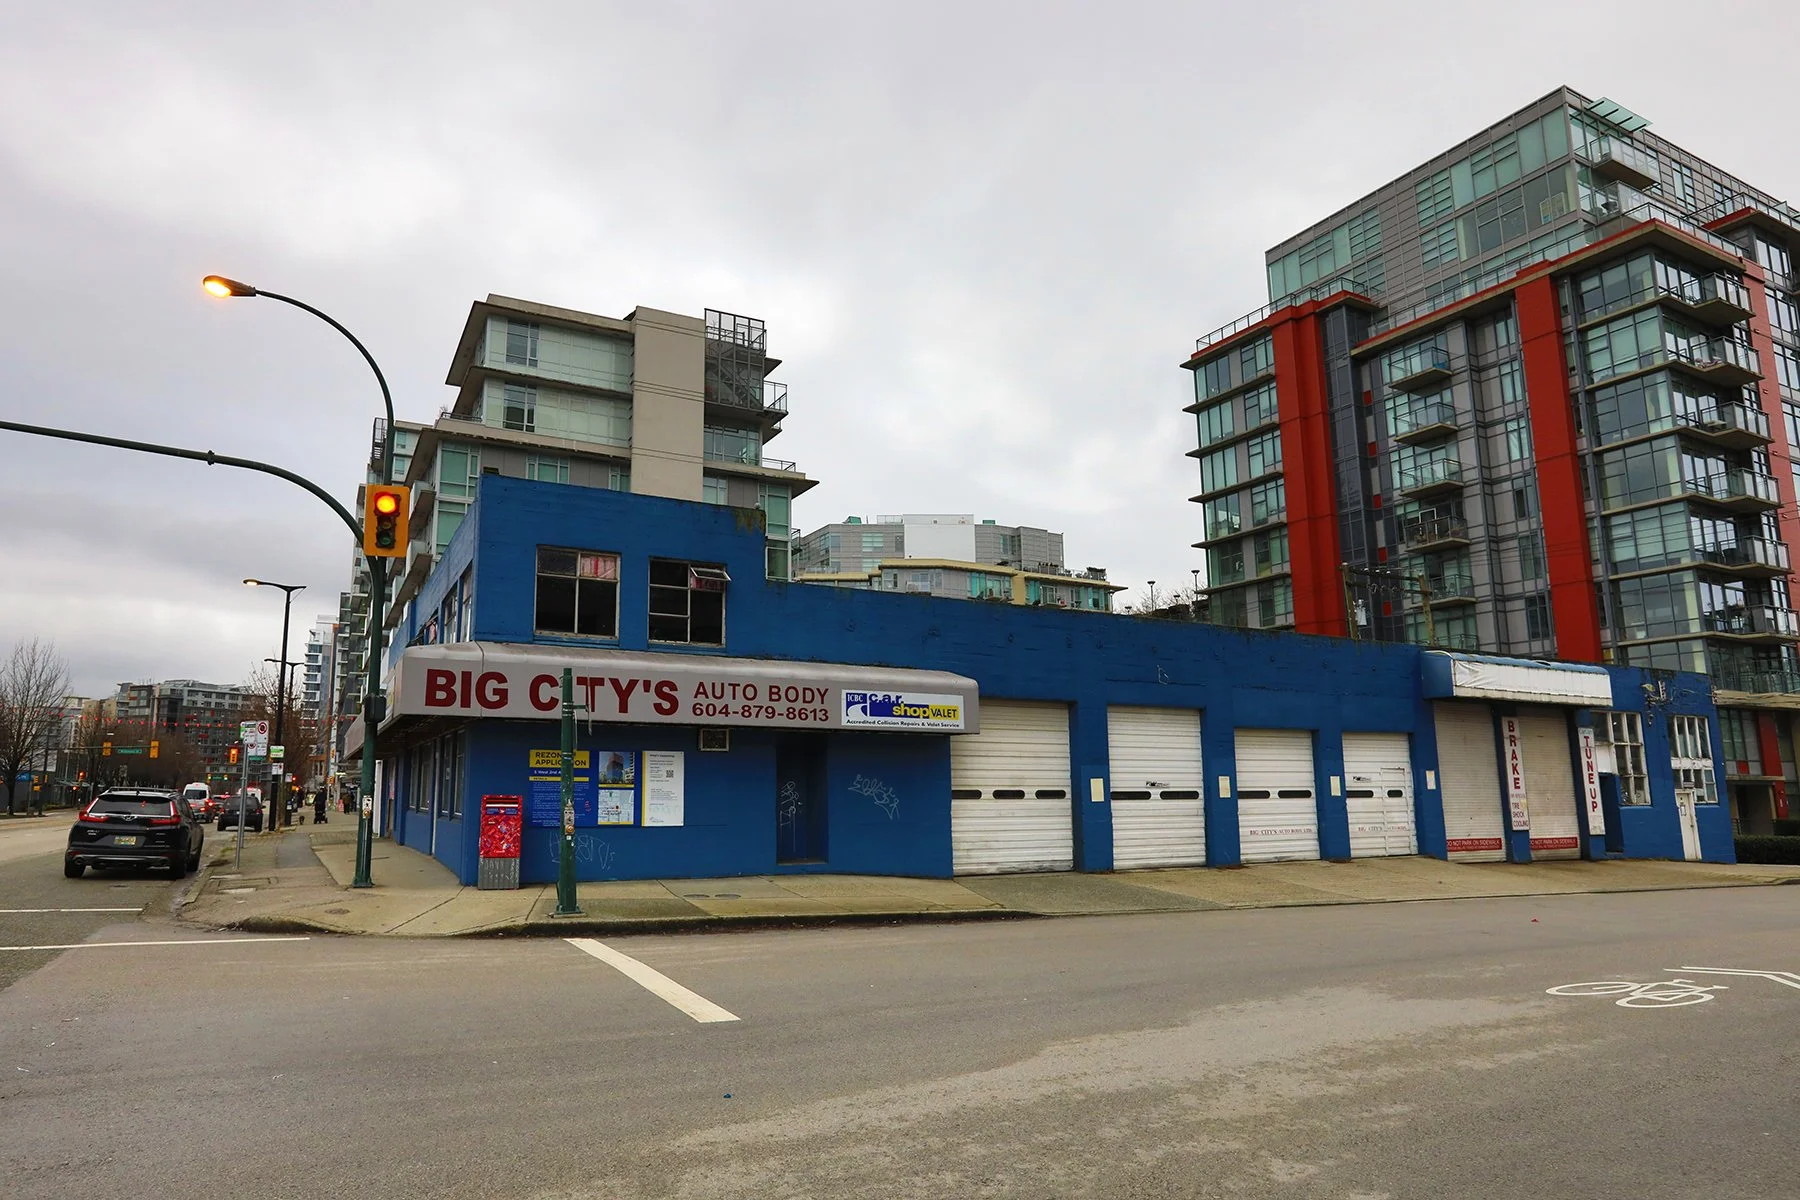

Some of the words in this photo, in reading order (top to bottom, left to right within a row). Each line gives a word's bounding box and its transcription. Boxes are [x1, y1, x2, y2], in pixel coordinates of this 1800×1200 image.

[424, 668, 509, 710] BIG
[528, 673, 680, 716] CTY'S
[693, 681, 758, 701] AUTO
[768, 684, 830, 705] BODY
[847, 693, 864, 703] ICBC
[691, 702, 830, 722] 604-879-8613
[892, 702, 930, 719] shop
[930, 708, 958, 719] VALET
[877, 719, 900, 727] Collision
[900, 720, 921, 728] Repairs
[1507, 720, 1521, 790] BRAKE
[1583, 735, 1595, 785] TUNE
[1589, 787, 1598, 812] UP
[1513, 820, 1529, 828] COOLING
